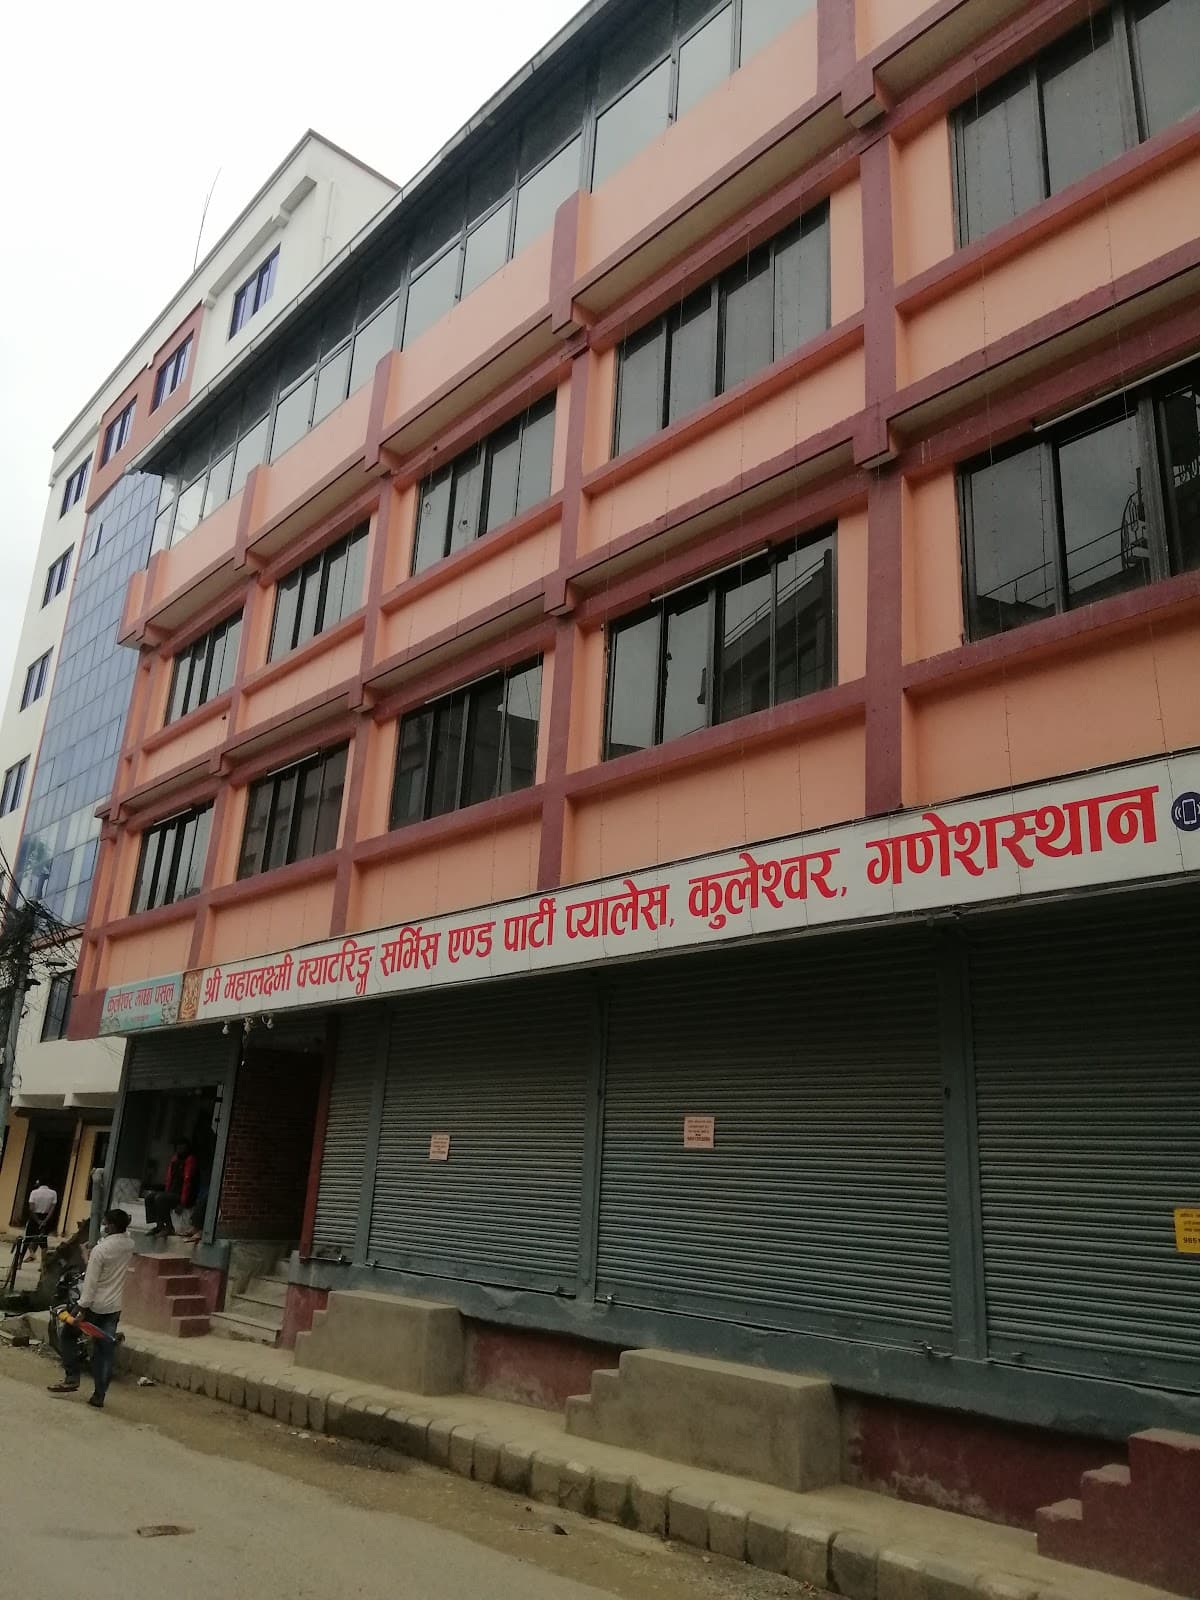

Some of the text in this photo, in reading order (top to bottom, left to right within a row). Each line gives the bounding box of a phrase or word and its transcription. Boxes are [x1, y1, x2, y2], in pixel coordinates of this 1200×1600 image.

[203, 968, 222, 1005] श्री
[223, 953, 294, 1001] महालक्ष्मी
[448, 921, 496, 963] एण्ड
[504, 897, 557, 952] पार्टी
[565, 879, 675, 940] प्यालेस,
[688, 848, 848, 929] कुलेश्वर,
[866, 785, 1160, 885] गणेशस्थान
